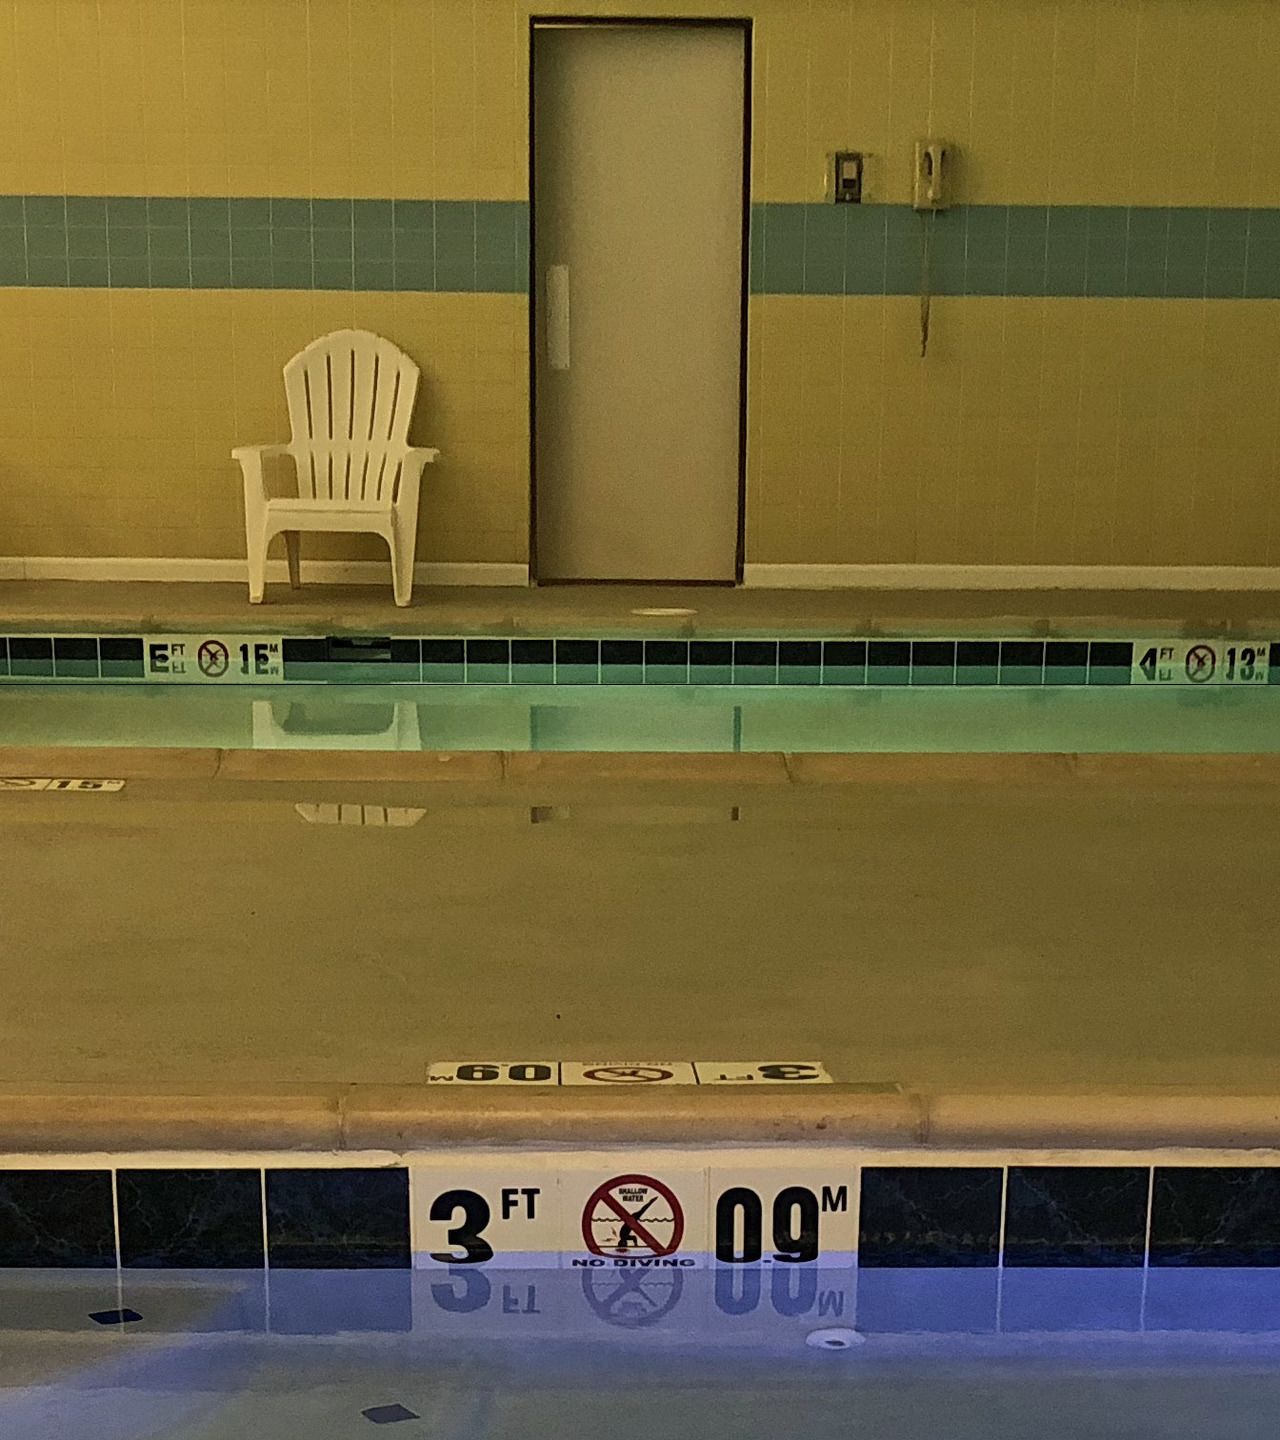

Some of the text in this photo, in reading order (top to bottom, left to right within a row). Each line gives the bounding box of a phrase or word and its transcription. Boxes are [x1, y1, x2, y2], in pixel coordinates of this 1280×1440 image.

[757, 1064, 819, 1080] 3
[821, 1186, 848, 1212] M
[429, 1188, 541, 1264] 3 FT
[572, 1258, 696, 1267] NO DIVING
